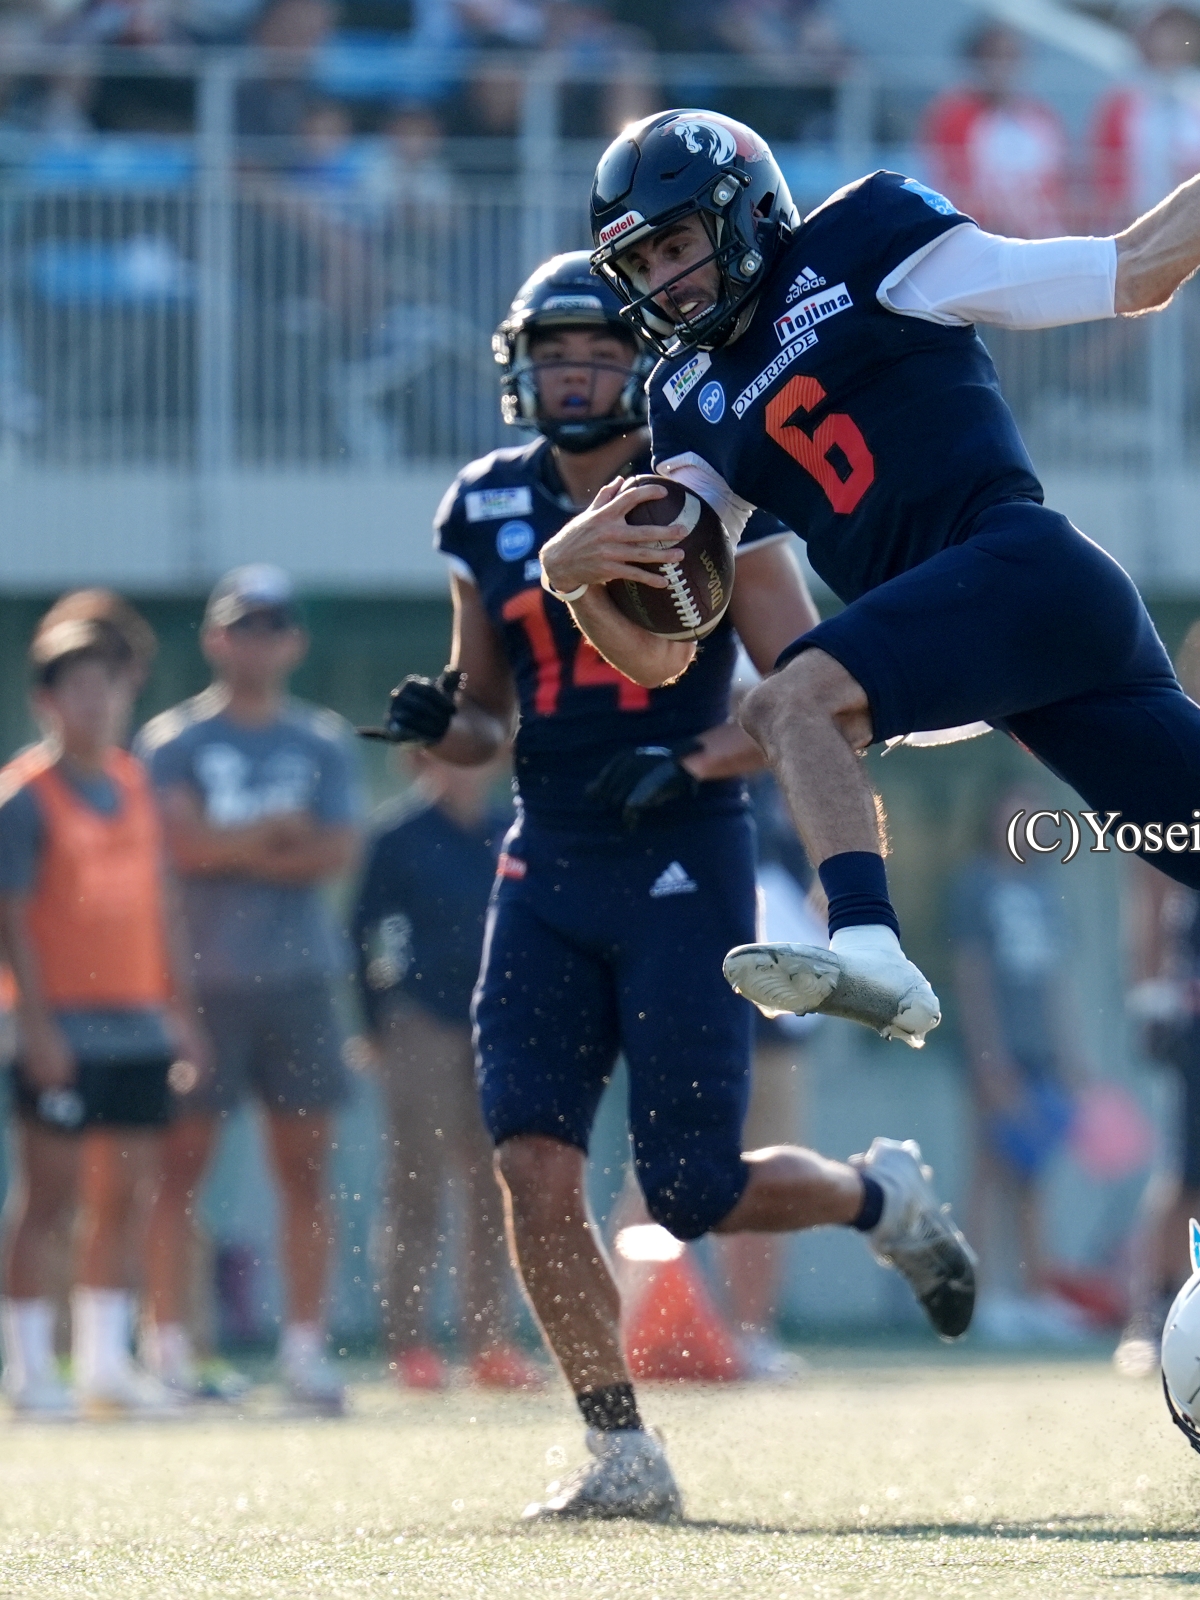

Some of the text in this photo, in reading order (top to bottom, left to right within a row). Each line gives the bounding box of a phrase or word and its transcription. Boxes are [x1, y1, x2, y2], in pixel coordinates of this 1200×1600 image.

[600, 214, 635, 243] Riddell
[785, 275, 827, 304] adidas
[734, 331, 817, 415] OVERRIDE
[765, 374, 874, 515] 6
[699, 549, 724, 611] Wilson
